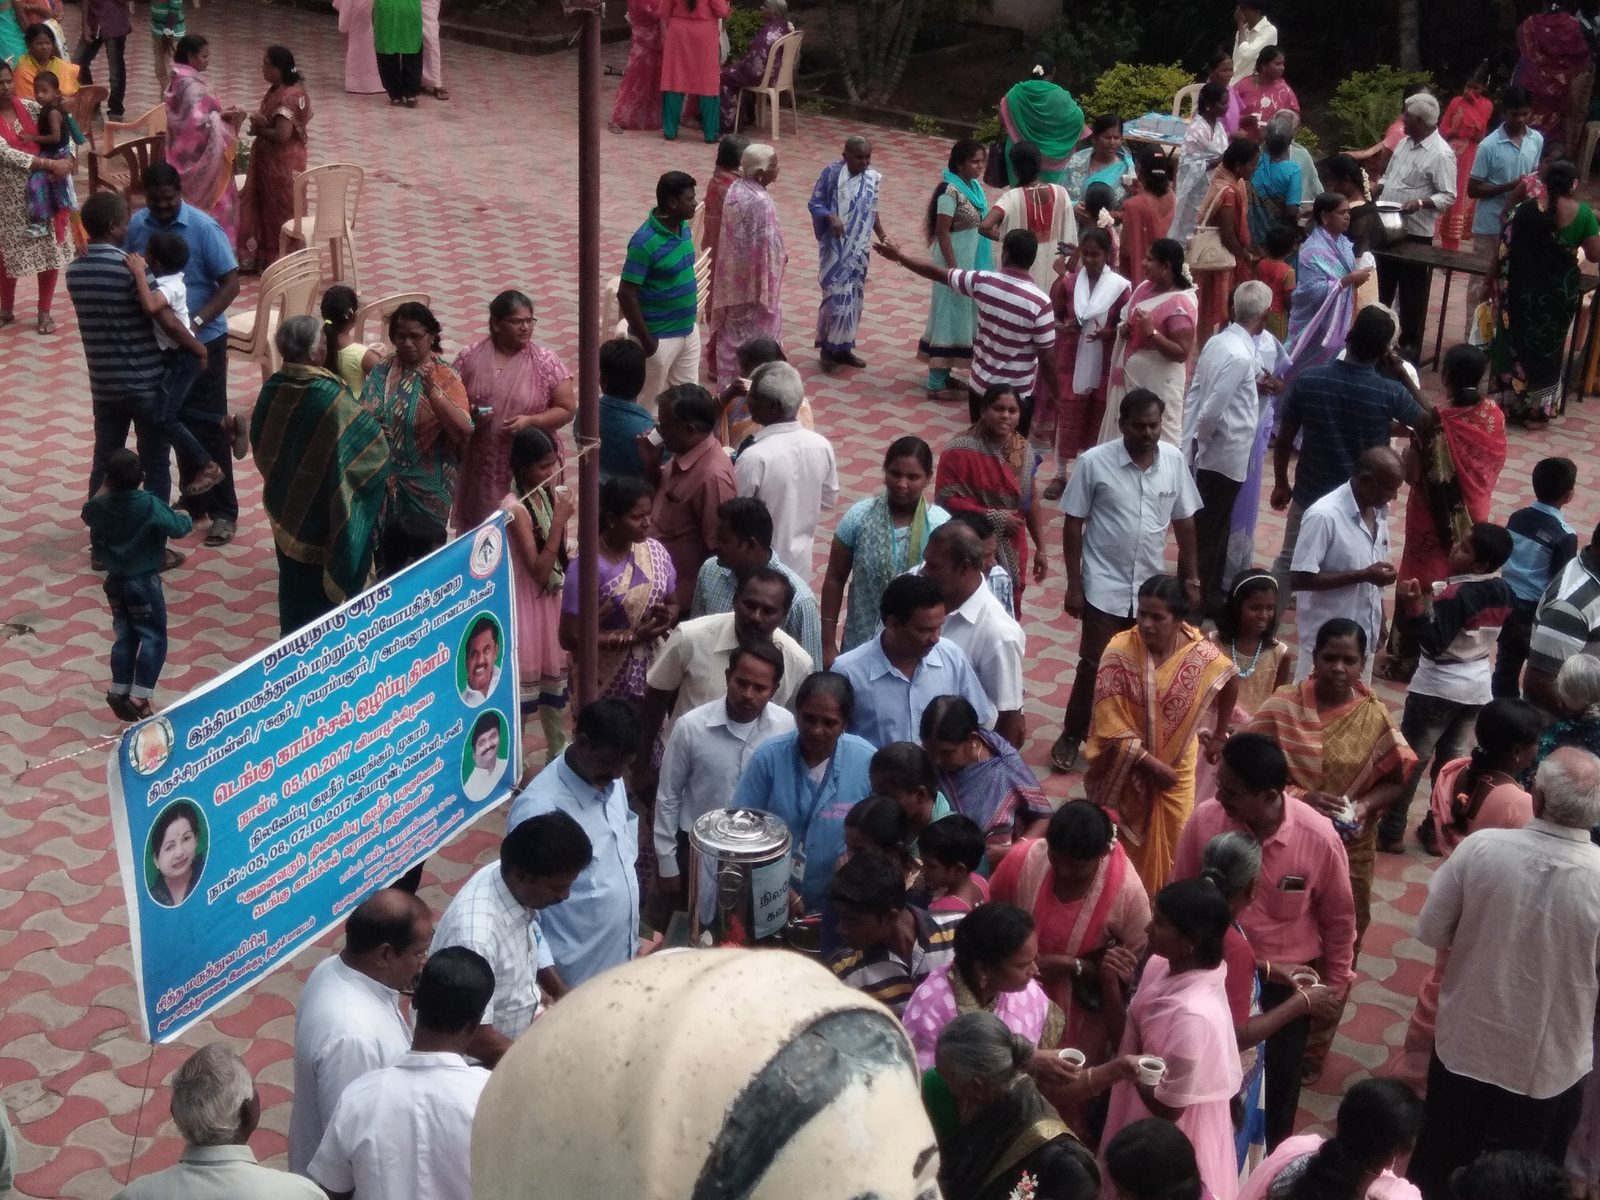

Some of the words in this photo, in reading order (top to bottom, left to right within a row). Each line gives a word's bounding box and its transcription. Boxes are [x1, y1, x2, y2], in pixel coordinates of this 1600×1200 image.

[148, 728, 252, 804] திருச்சிராப்பள்ளி
[305, 658, 368, 705] பெரம்பலூர்
[187, 707, 238, 748] இந்திய
[238, 662, 309, 717] மருத்துவம்
[309, 636, 356, 674] மற்றும்
[214, 757, 275, 805] டெங்கு
[275, 702, 354, 766] காய்ச்சல்
[355, 676, 407, 722] ஒழிப்பு
[406, 644, 450, 692] தினம்
[250, 804, 306, 850] நிலவேம்பு
[311, 778, 343, 810] குடிநீர்
[349, 746, 393, 783] வழங்கும்
[398, 722, 428, 752] முகாம்
[282, 742, 352, 798] 05.10.2017
[246, 856, 268, 874] 05,
[291, 797, 353, 844] 07.10.2017
